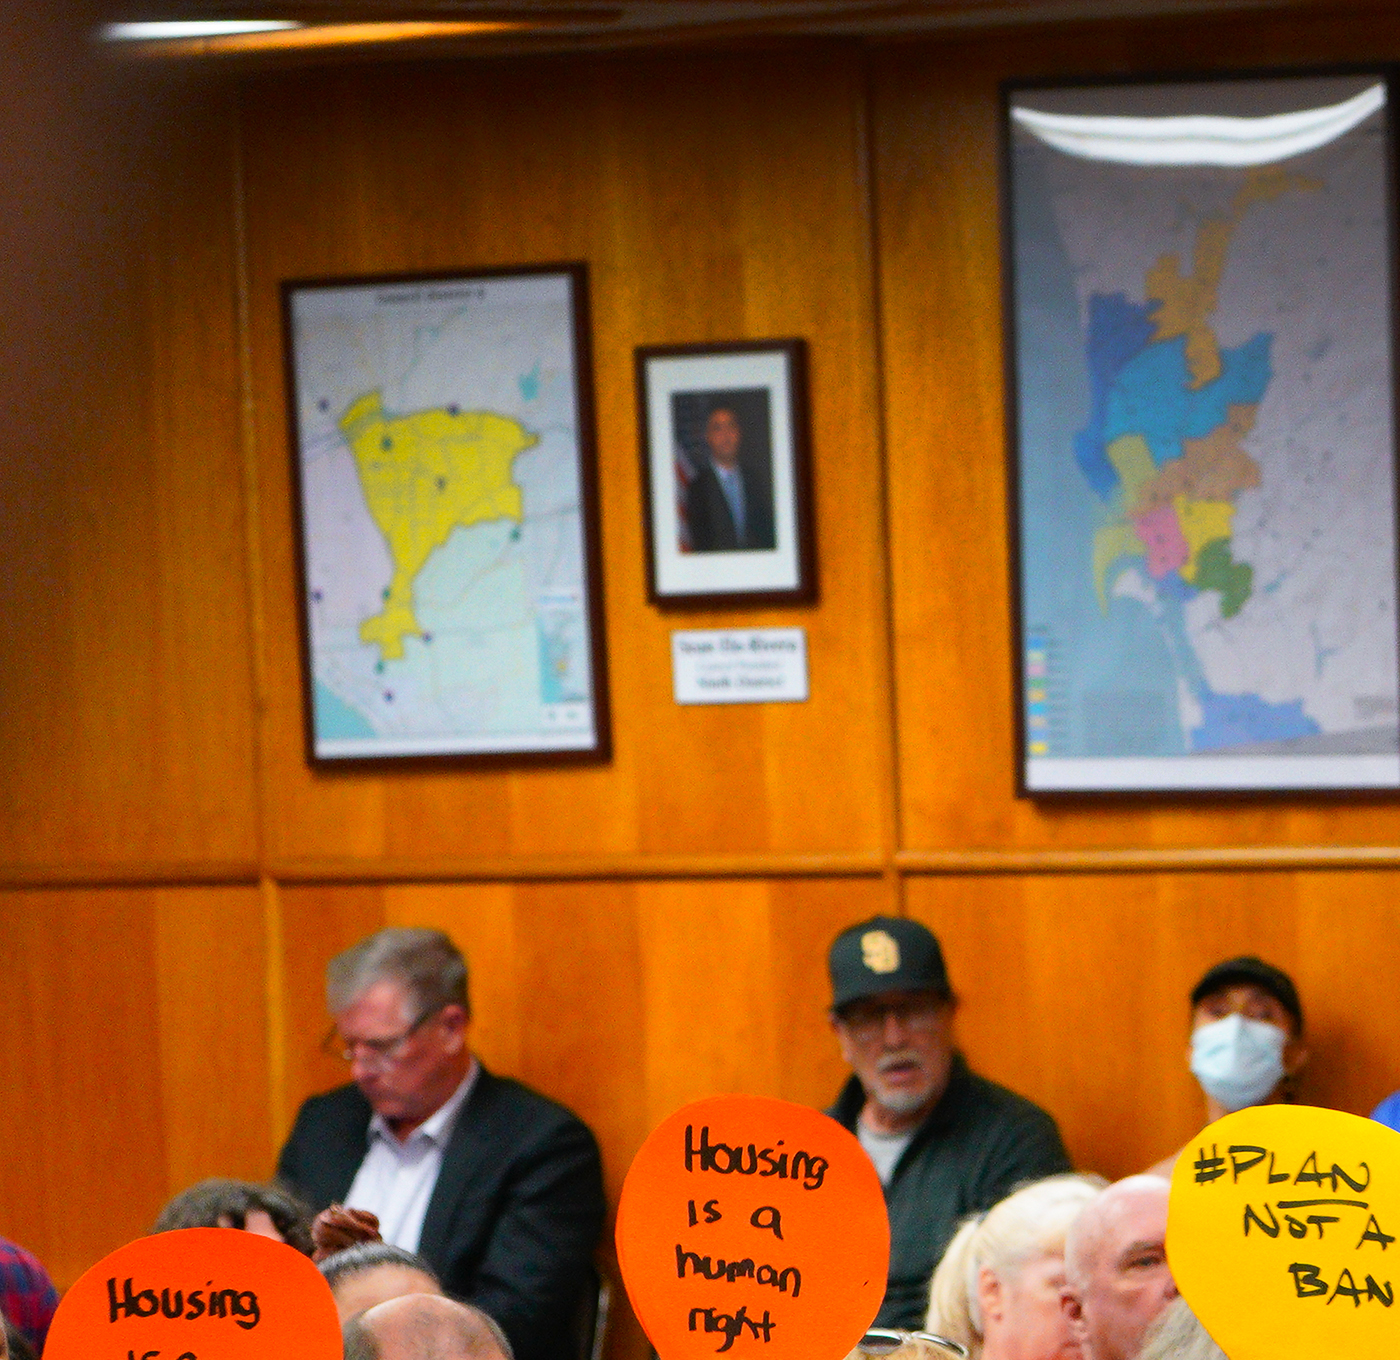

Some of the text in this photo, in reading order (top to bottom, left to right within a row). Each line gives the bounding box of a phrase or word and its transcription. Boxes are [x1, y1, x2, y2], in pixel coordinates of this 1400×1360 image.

[685, 1124, 829, 1190] Housing
[1194, 1144, 1371, 1193] #PLAN
[750, 1206, 784, 1240] a
[1244, 1202, 1396, 1251] NOT A
[675, 1244, 801, 1298] human
[1288, 1262, 1394, 1308] BAN
[106, 1277, 261, 1330] Housing
[688, 1306, 776, 1353] right
